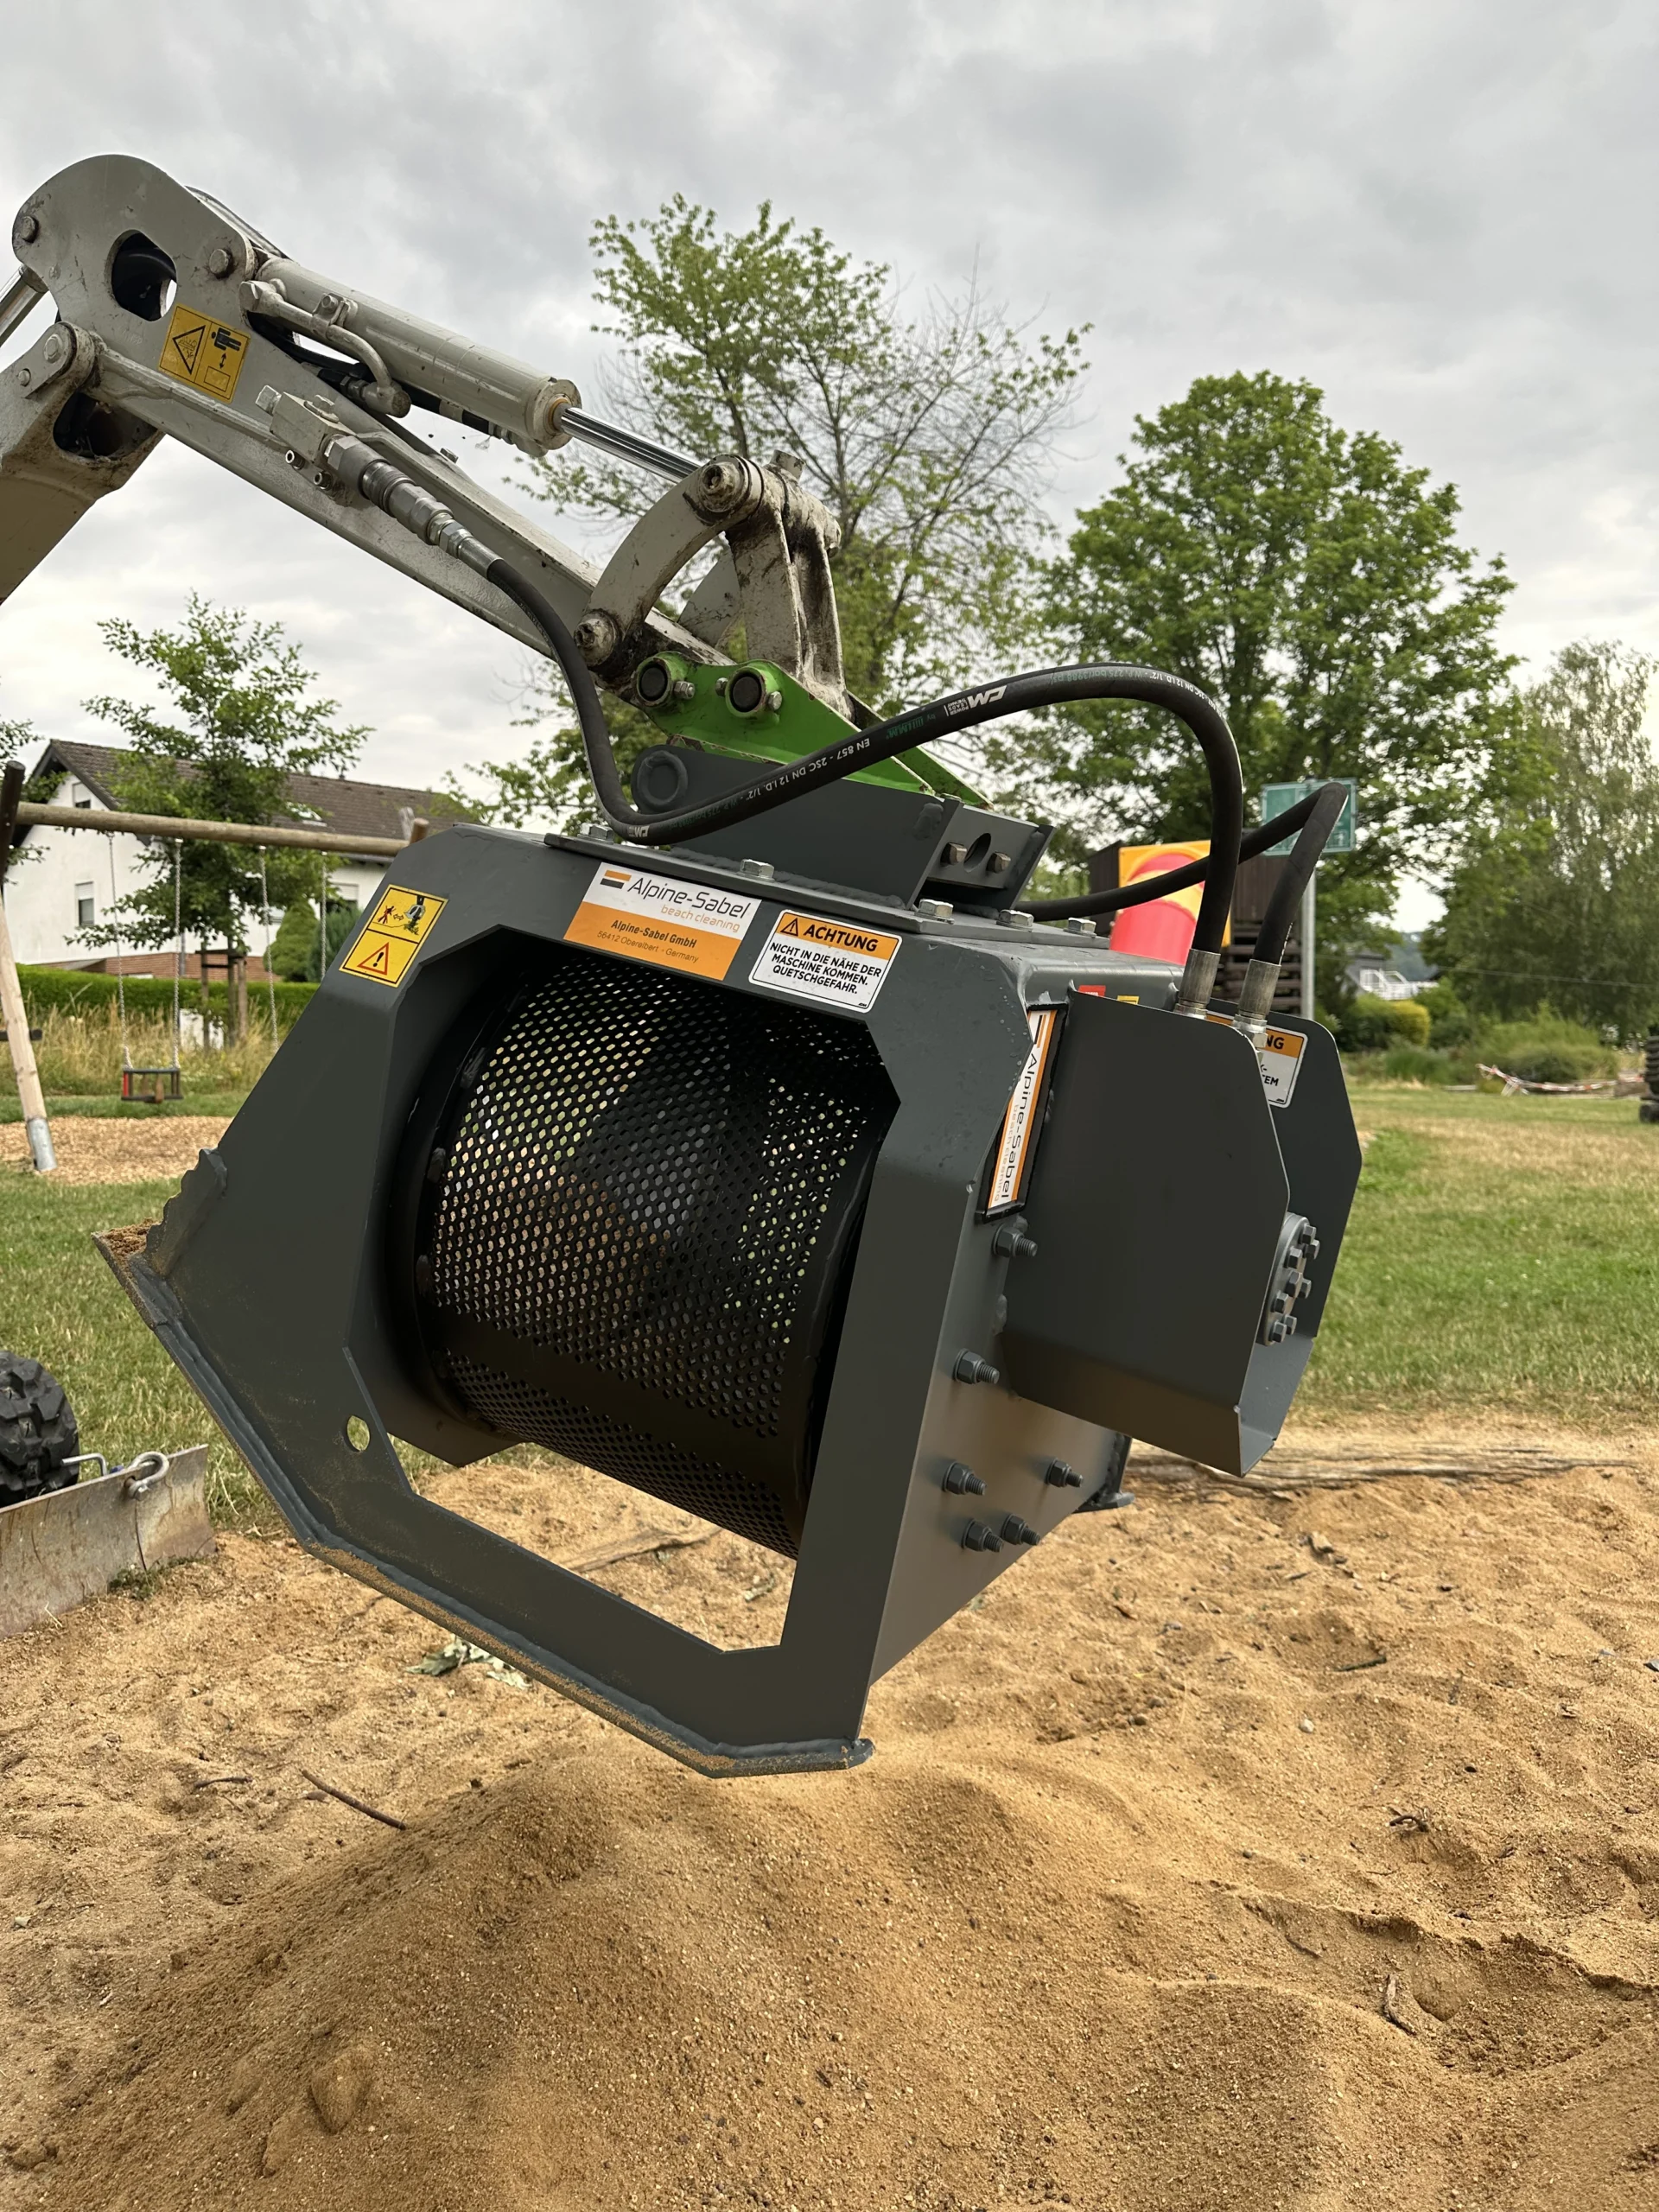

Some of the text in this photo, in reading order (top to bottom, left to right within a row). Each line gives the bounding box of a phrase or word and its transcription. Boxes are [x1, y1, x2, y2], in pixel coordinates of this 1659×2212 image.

[1109, 669, 1123, 677] 275
[1176, 678, 1184, 688] 12
[967, 685, 1007, 709] CM
[836, 746, 854, 760] 857
[856, 738, 870, 751] EN
[792, 766, 806, 779] DN
[809, 757, 828, 772] 2SC
[779, 775, 790, 785] 12
[627, 877, 751, 918] Alpine-Sabel
[660, 904, 741, 933] beach cleaning
[597, 931, 620, 943] 56412
[665, 948, 699, 963] Germany
[611, 919, 697, 948] Alpine-Sabel GmbH
[803, 924, 879, 951] ACHTUNG
[770, 942, 881, 977] NICHT IN DIE NÄHE DER
[772, 953, 868, 986] MASCHINE KOMMEN.
[772, 965, 857, 994] QUETSCHGEFAHR.
[1001, 1053, 1037, 1198] Alpine-Sabel
[995, 1104, 1019, 1202] beach cleaning
